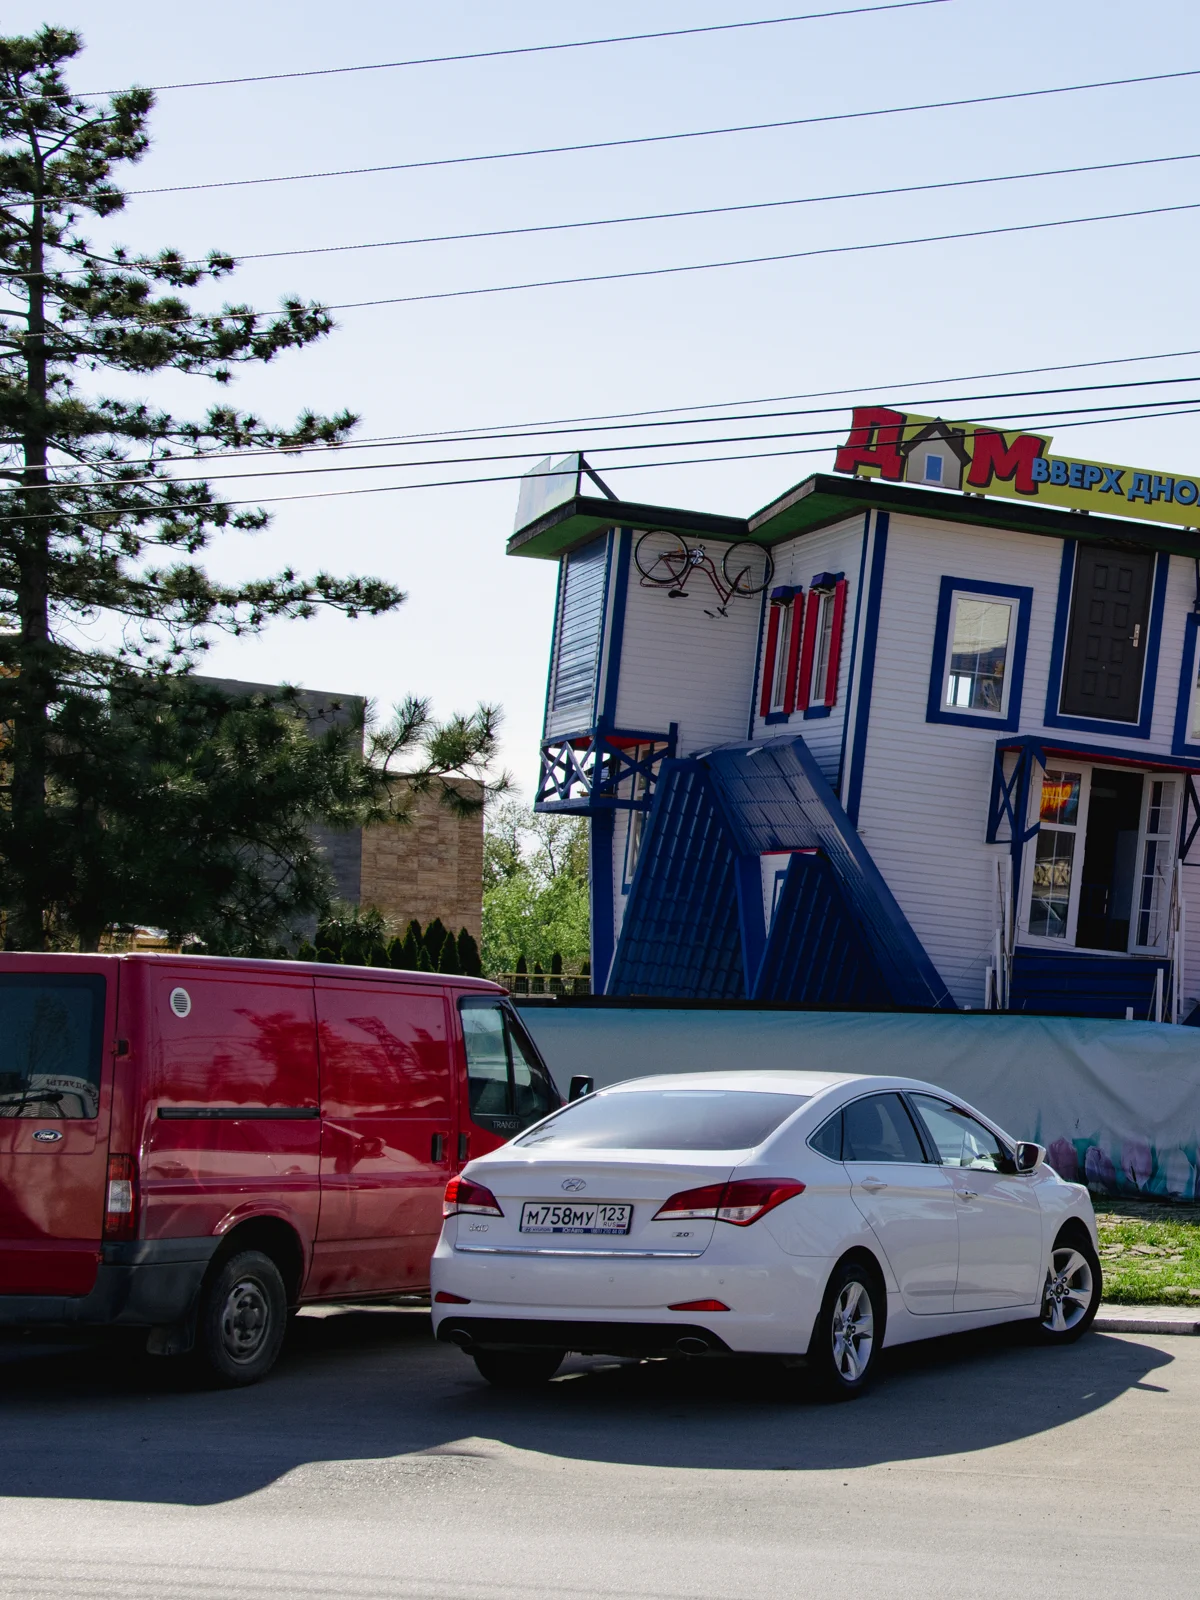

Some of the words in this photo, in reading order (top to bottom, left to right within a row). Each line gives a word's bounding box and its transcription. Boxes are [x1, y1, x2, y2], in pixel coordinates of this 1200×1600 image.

[1030, 457, 1127, 495] ВВЕРХ
[492, 1120, 520, 1129] TRANSIT
[600, 1207, 626, 1221] 123
